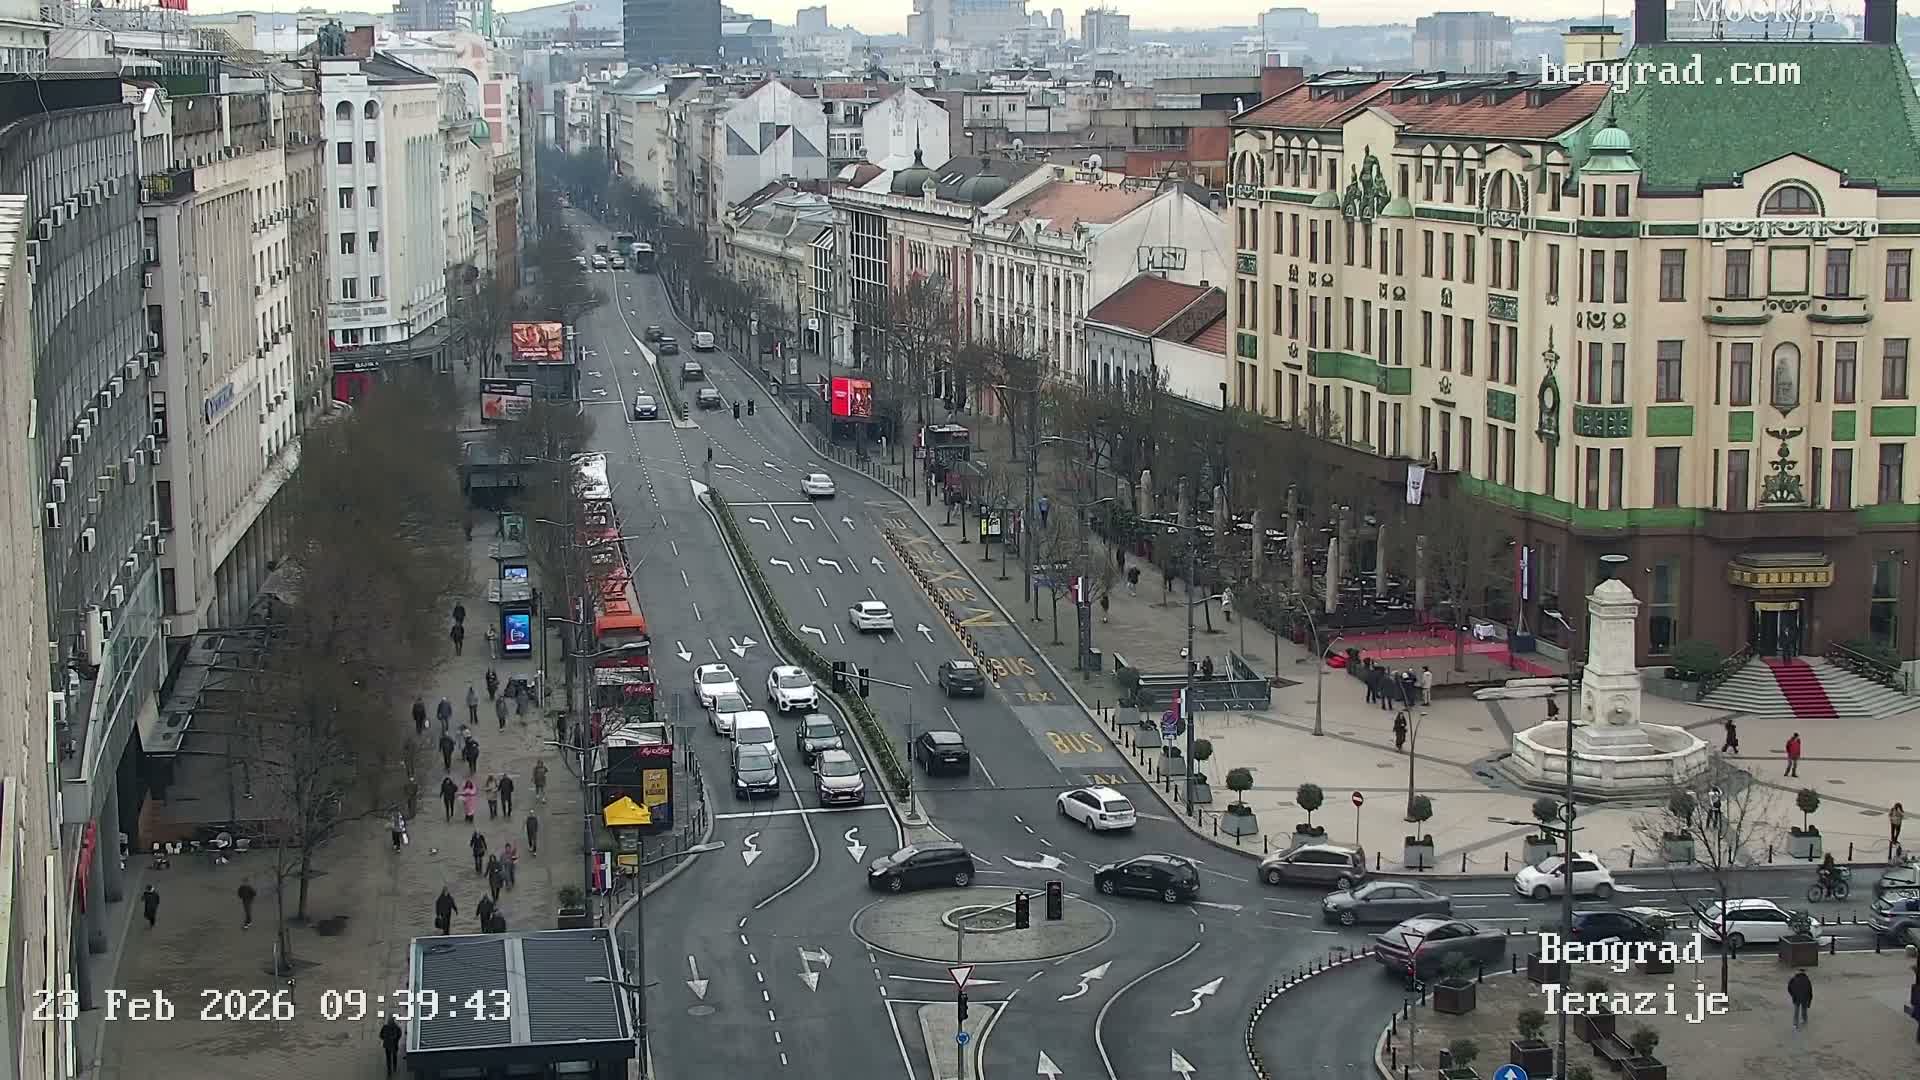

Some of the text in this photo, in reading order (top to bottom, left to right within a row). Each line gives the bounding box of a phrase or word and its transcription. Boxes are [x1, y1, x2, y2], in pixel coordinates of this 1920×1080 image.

[938, 587, 978, 602] BUS
[991, 656, 1036, 676] BUS
[1045, 731, 1105, 753] BUS
